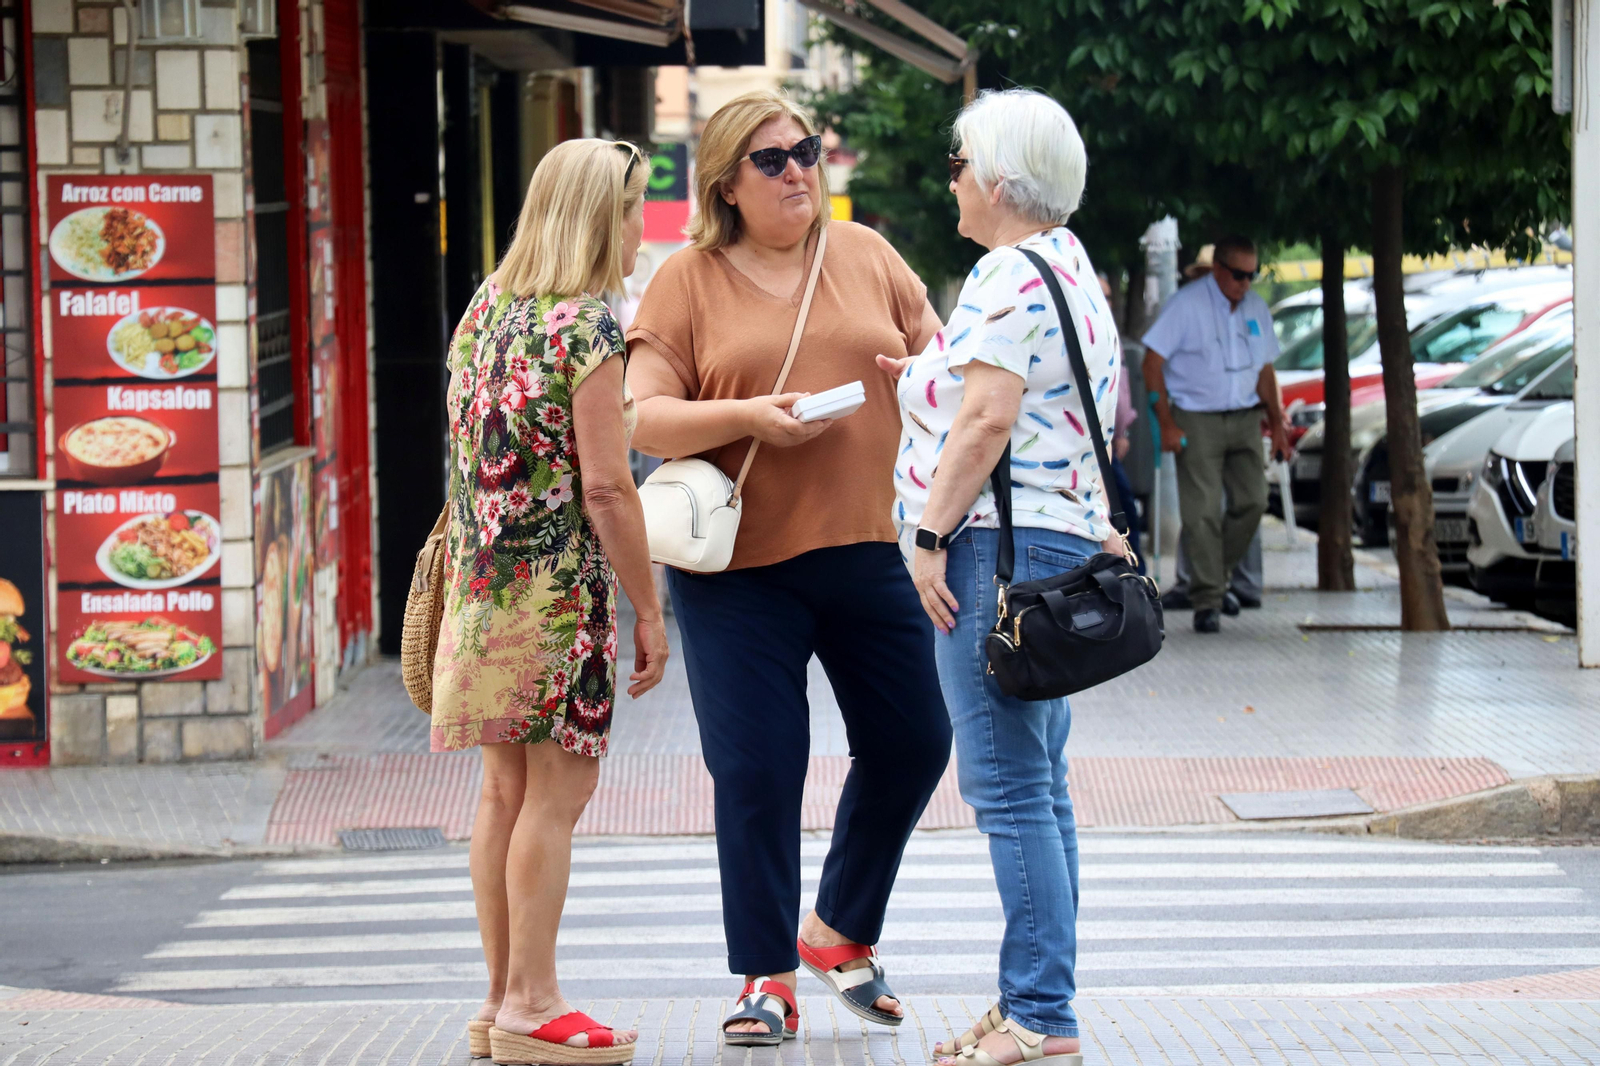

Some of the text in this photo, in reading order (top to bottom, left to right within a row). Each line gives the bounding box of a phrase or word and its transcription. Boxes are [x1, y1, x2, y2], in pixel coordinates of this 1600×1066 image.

[61, 182, 203, 203] Arroz con Carne
[59, 290, 139, 317] Falafel
[106, 385, 212, 412] Kapsalon
[63, 490, 177, 514] Plato Mixto
[80, 591, 214, 614] Ensalada Pollo
